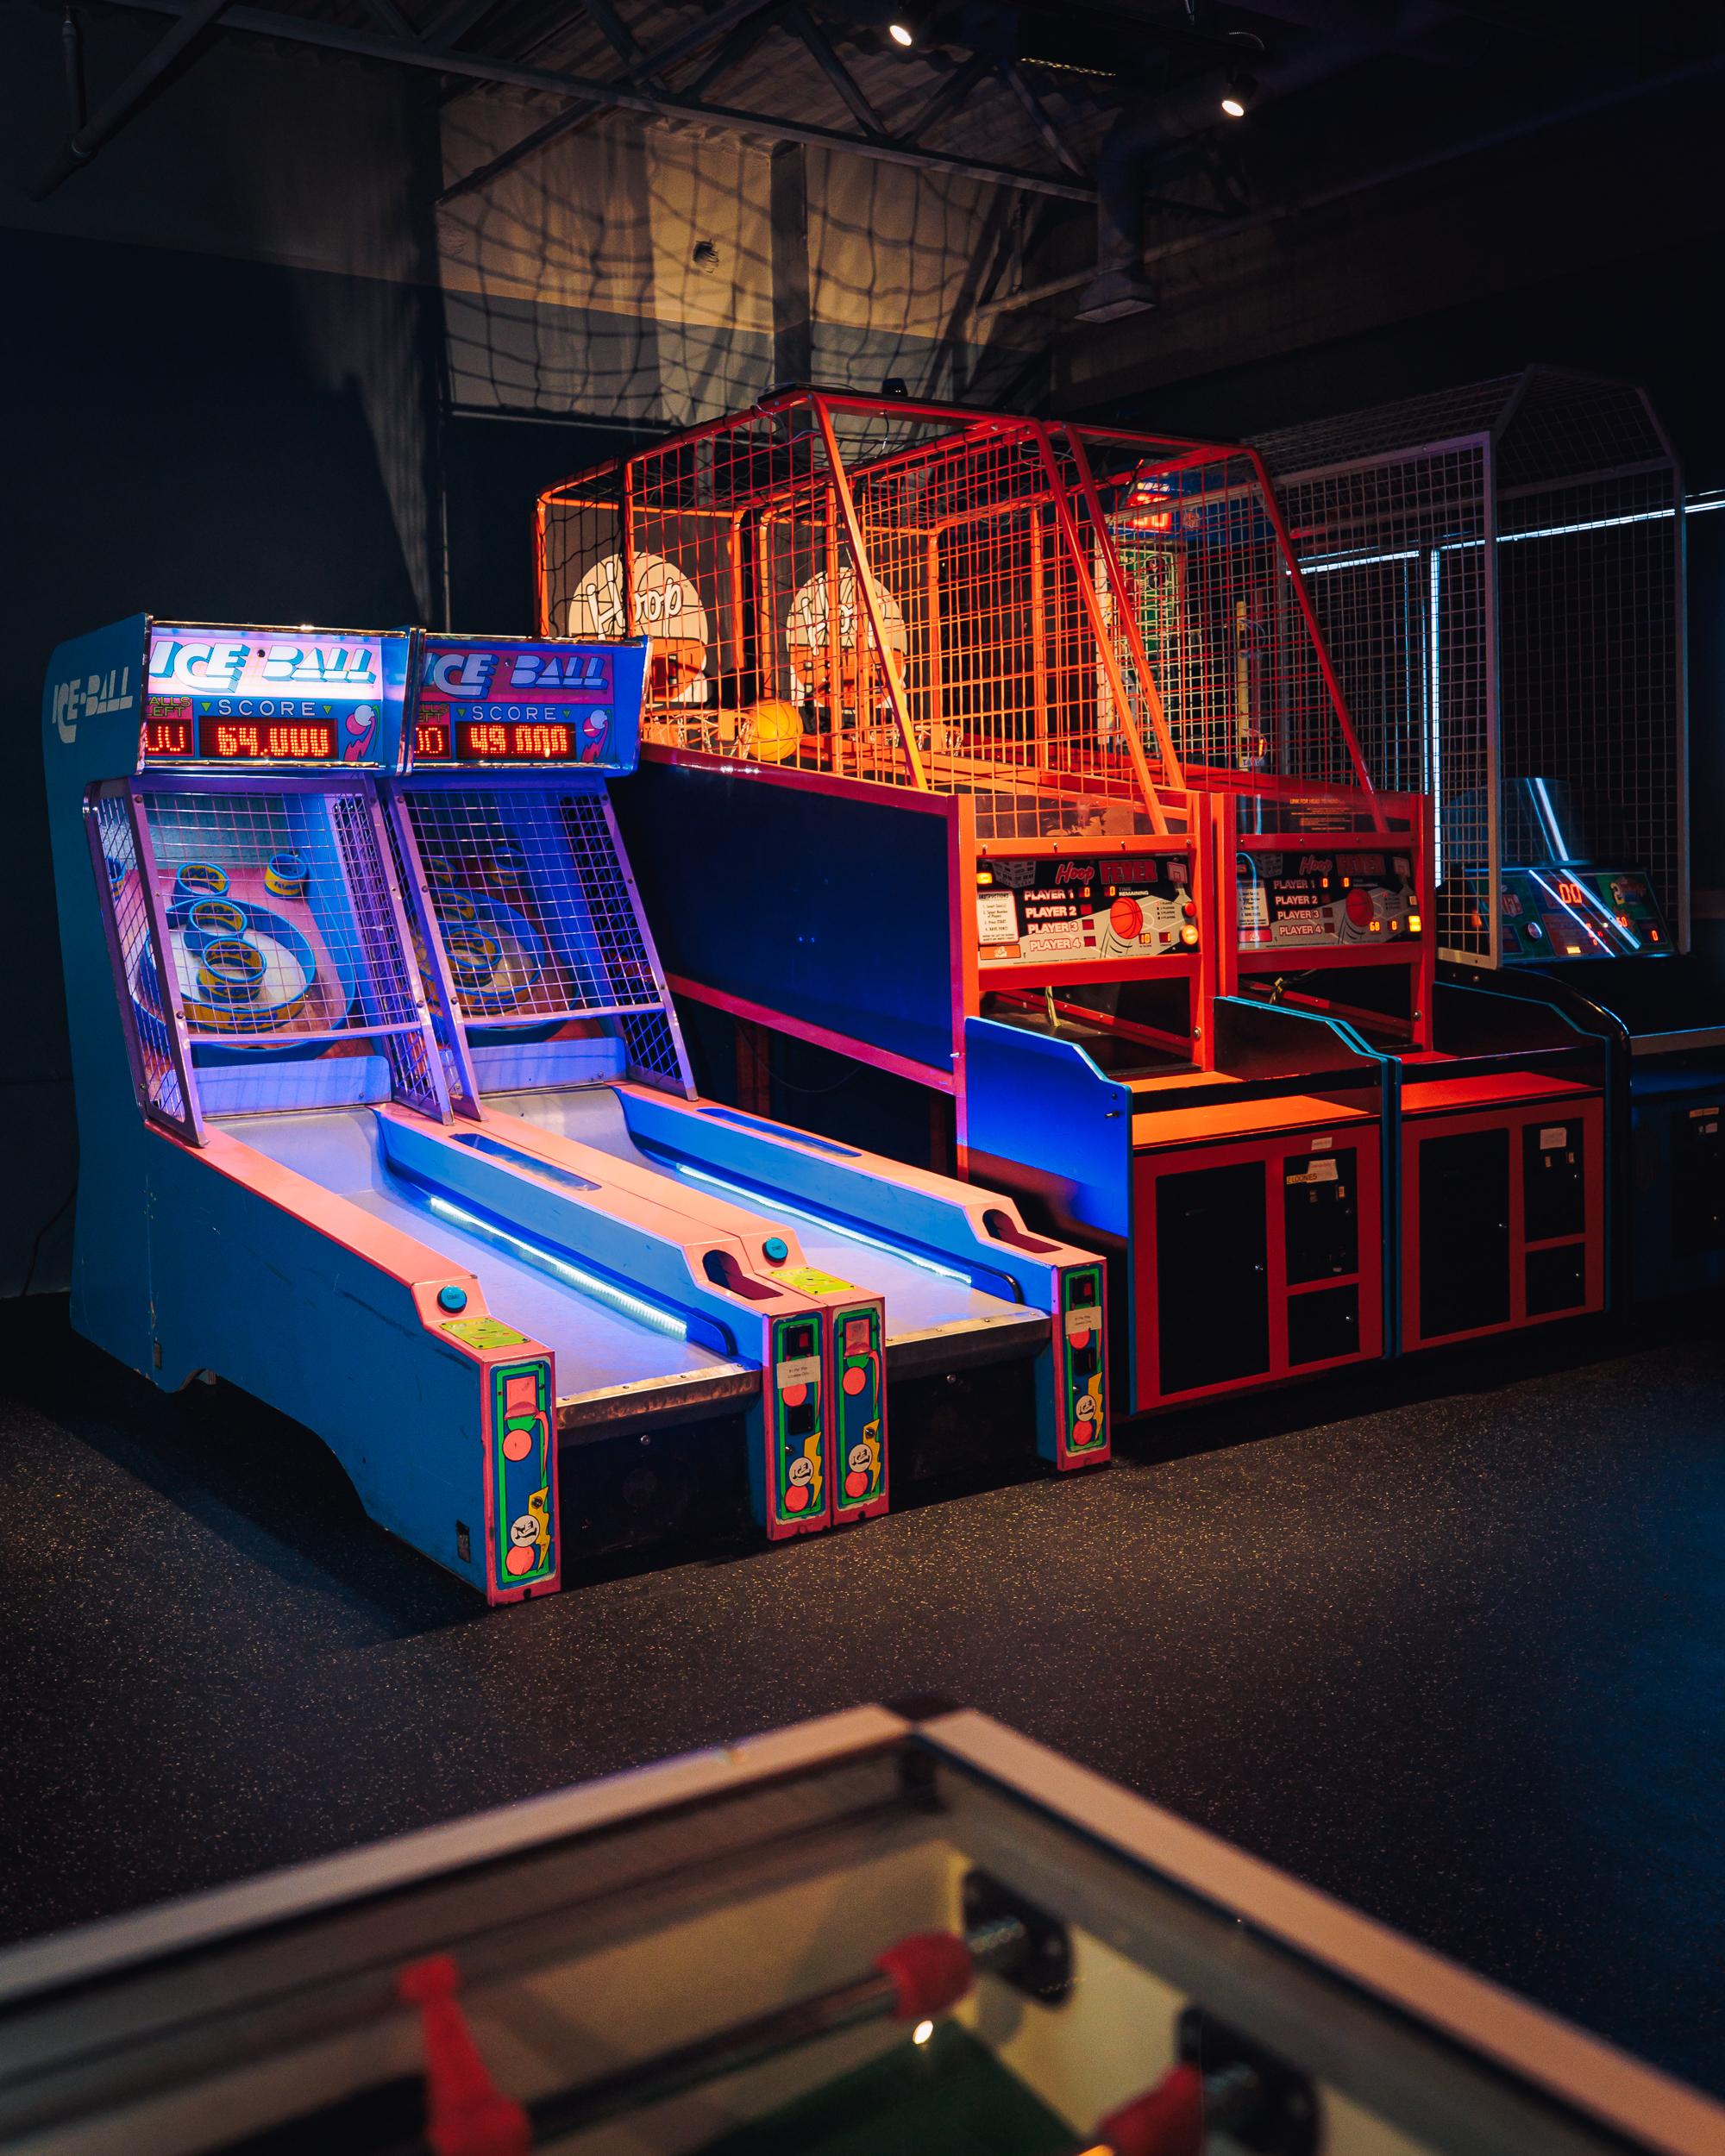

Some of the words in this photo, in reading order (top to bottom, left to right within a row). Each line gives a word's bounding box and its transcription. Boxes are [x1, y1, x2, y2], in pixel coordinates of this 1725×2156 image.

[148, 641, 251, 693] ICE
[262, 645, 377, 684] BALL
[510, 655, 609, 690] BALL
[148, 697, 191, 707] ALLS
[217, 699, 316, 716] SCORE
[420, 703, 448, 713] LLS
[472, 705, 556, 720] SCORE
[417, 712, 443, 723] EFT
[1299, 855, 1333, 876] Hoop
[1336, 854, 1385, 876] FEVER
[1055, 862, 1095, 885] Hoop
[1100, 859, 1158, 885] FEVER
[1273, 880, 1308, 889] PLAYER
[1310, 880, 1315, 888] 1
[1322, 878, 1329, 888] 0
[1343, 877, 1350, 887] 0
[1024, 889, 1066, 901] PLAYER
[1068, 888, 1075, 899] 1
[1084, 887, 1091, 897] 0
[1109, 886, 1116, 896] 0
[1559, 883, 1583, 904] 00
[1275, 895, 1310, 906] PLAYER
[1312, 895, 1318, 904] 2
[1025, 906, 1068, 918] PLAYER
[1069, 906, 1077, 916] 2
[1277, 910, 1312, 920] PLAYER
[1314, 910, 1320, 919] 3
[1027, 921, 1070, 934] PLAYER
[1070, 920, 1079, 931] 3
[1280, 925, 1314, 936] PLAYER
[1315, 924, 1322, 934] 4
[1391, 920, 1397, 931] 0
[1140, 933, 1151, 943] 10
[1167, 932, 1171, 942] 1
[1651, 930, 1659, 941] 0
[1030, 937, 1072, 952] PLAYER
[1072, 937, 1082, 949] 4
[1292, 1173, 1317, 1182] LOONIES
